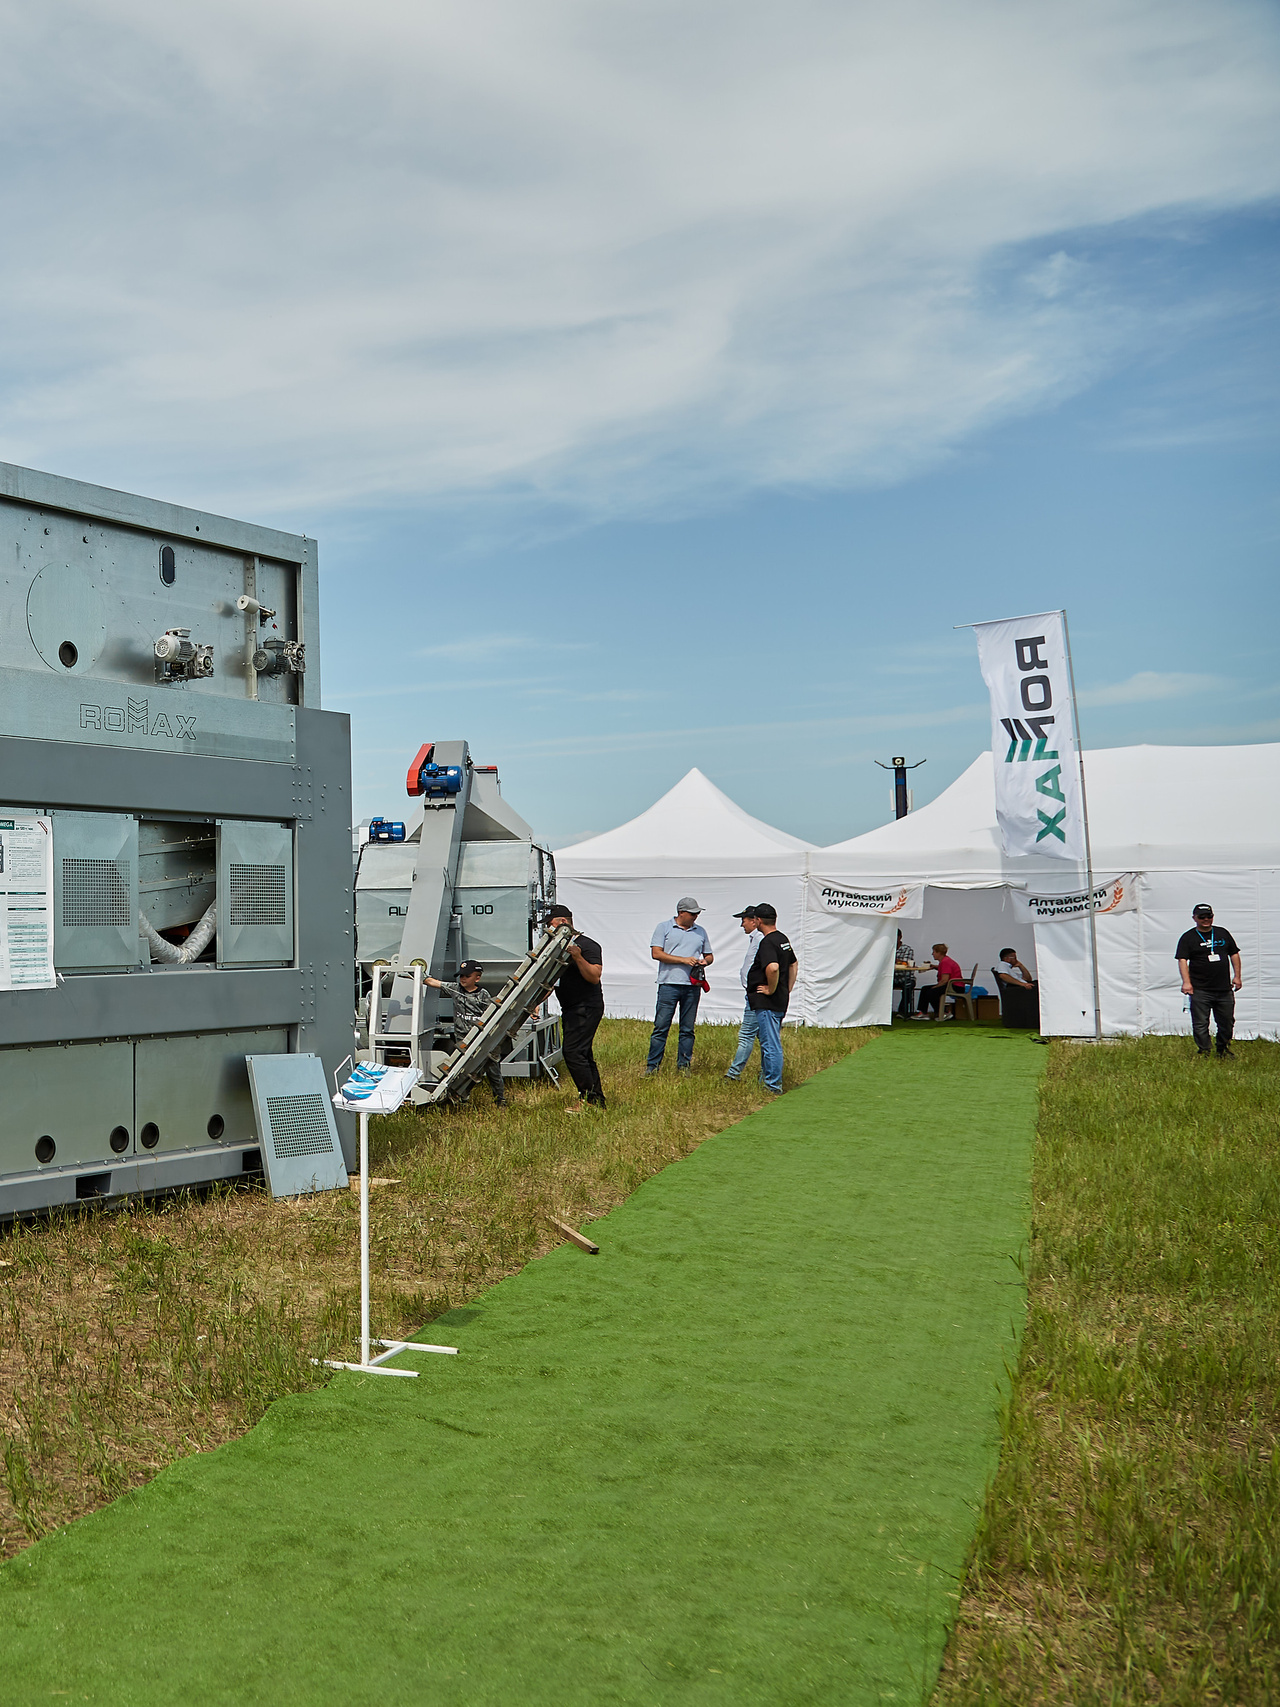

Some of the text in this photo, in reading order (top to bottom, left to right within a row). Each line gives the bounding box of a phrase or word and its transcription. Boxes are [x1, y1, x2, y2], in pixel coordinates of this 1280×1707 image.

[79, 696, 197, 741] ROMAX
[821, 887, 892, 902] Алтайский
[471, 904, 494, 915] 100
[827, 898, 885, 908] мукомол
